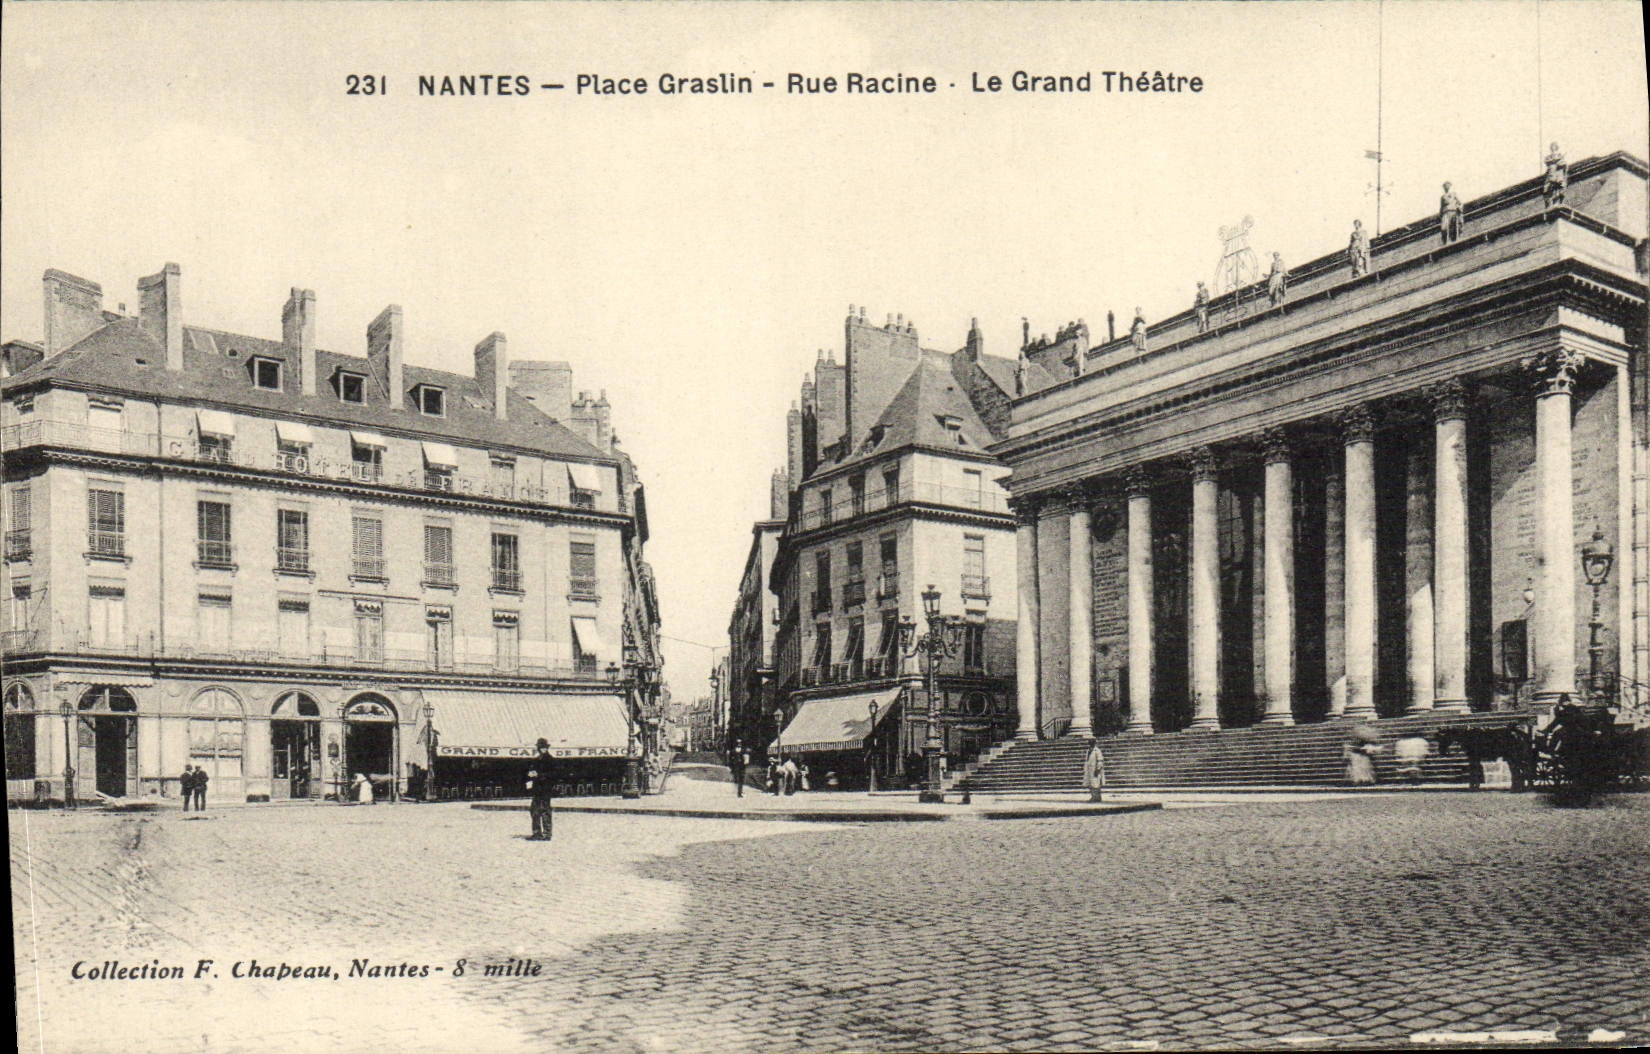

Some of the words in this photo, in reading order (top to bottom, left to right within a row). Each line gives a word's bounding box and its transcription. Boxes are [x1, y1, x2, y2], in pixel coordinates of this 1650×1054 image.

[168, 440, 256, 466] GAD
[440, 746, 500, 756] GRAND
[508, 747, 540, 757] CAF
[577, 747, 637, 757] FRANC
